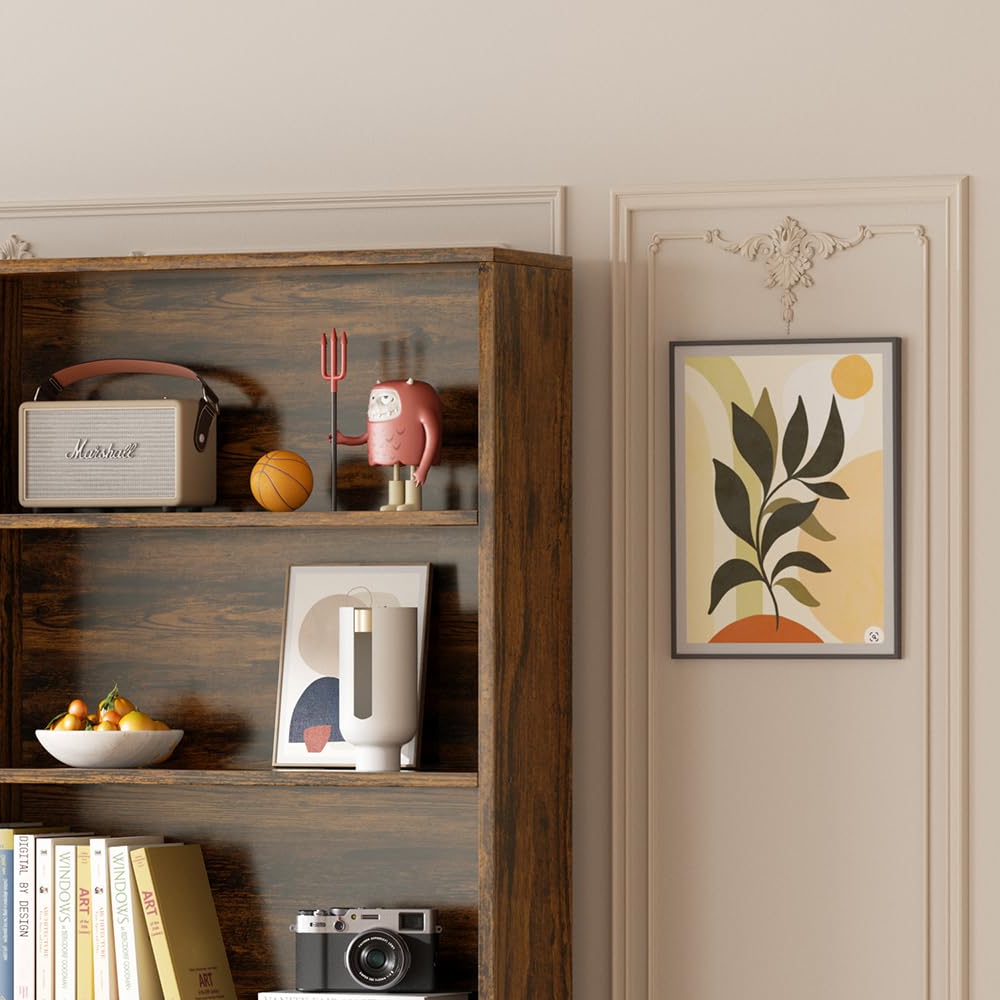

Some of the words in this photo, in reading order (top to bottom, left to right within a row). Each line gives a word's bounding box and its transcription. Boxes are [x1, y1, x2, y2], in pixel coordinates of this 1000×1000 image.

[64, 437, 139, 460] Marshall
[18, 836, 29, 876] DIGITAL
[18, 882, 29, 894] BY
[58, 852, 71, 923] WINDOWS
[112, 852, 129, 925] WINDOWS
[80, 888, 90, 915] ART
[142, 890, 158, 916] ART
[18, 900, 29, 938] DESIGN
[199, 972, 214, 988] ART
